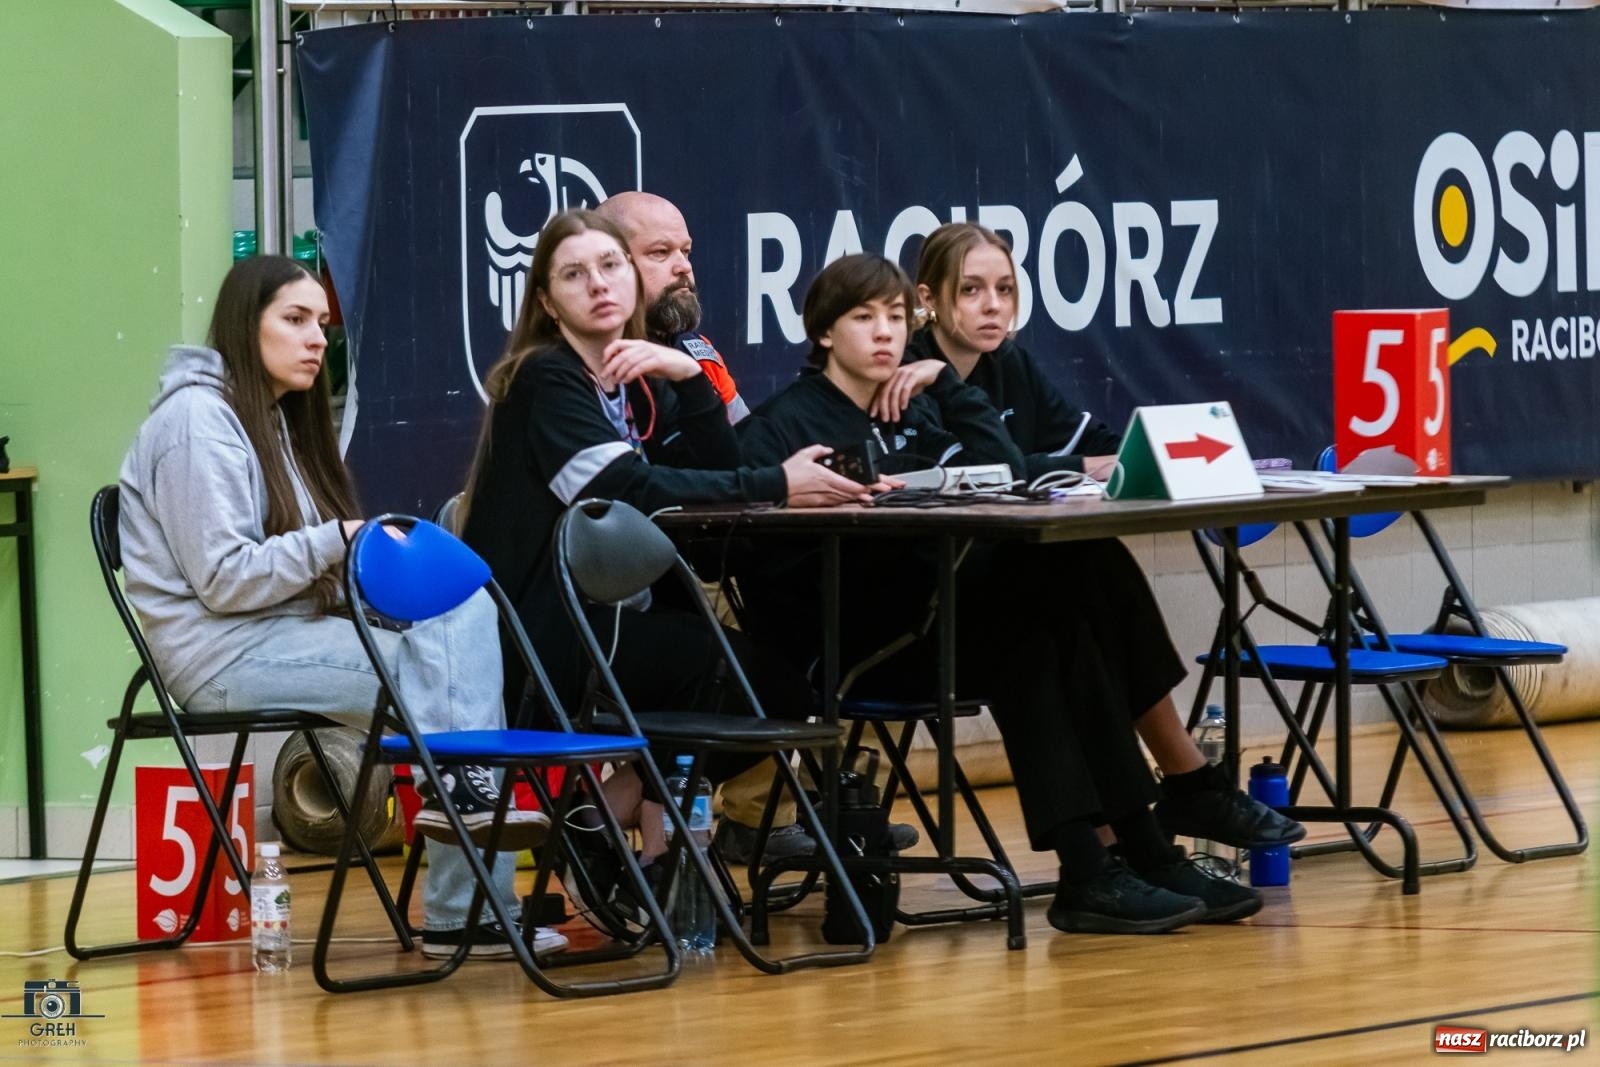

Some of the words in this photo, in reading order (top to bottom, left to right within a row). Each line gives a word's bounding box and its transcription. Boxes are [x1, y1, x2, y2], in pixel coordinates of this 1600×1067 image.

[747, 153, 1223, 344] RBÓRZ
[1414, 129, 1600, 300] OSi
[1349, 329, 1405, 437] 5
[1424, 327, 1446, 437] 5
[1511, 316, 1600, 362] RACIB
[150, 785, 201, 896] 5
[224, 782, 249, 896] 5
